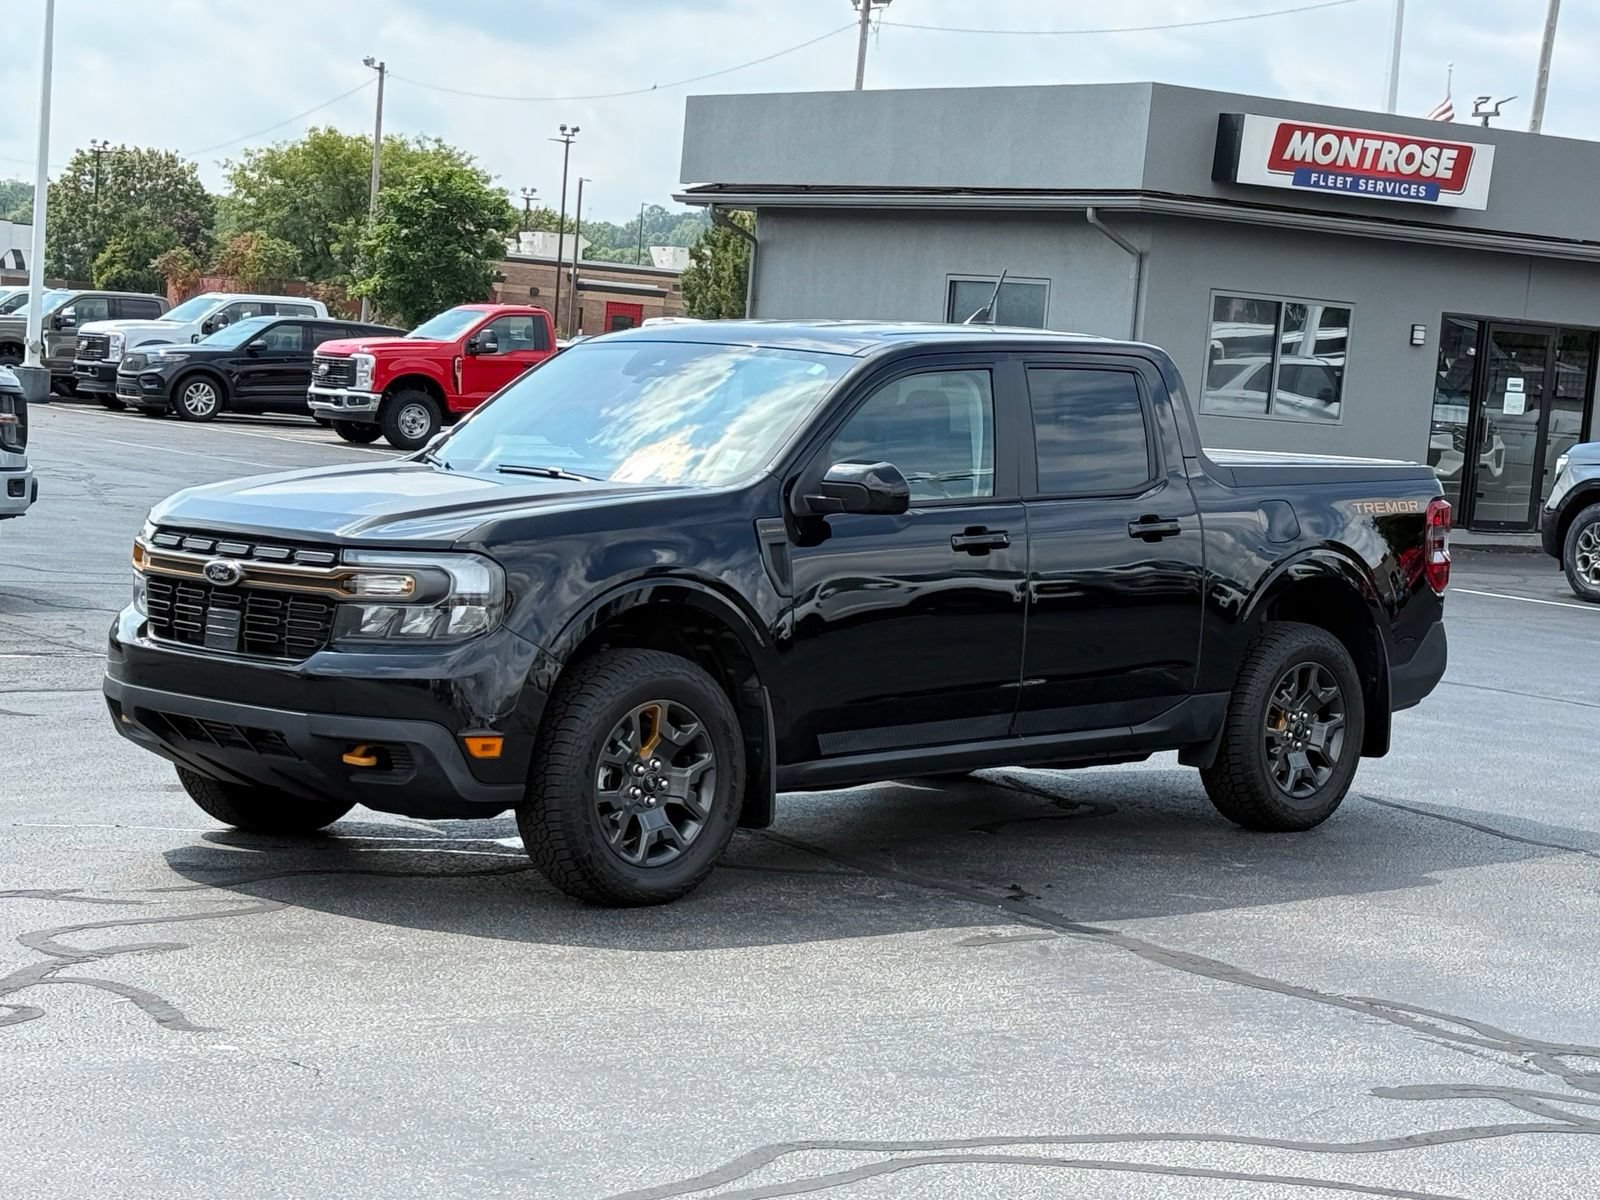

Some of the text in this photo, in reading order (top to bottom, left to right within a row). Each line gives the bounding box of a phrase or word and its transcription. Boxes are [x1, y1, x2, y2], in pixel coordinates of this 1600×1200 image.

[1282, 130, 1459, 179] MONTROSE
[1310, 173, 1427, 198] FLEET SERVICES
[1352, 501, 1419, 514] TREMOR
